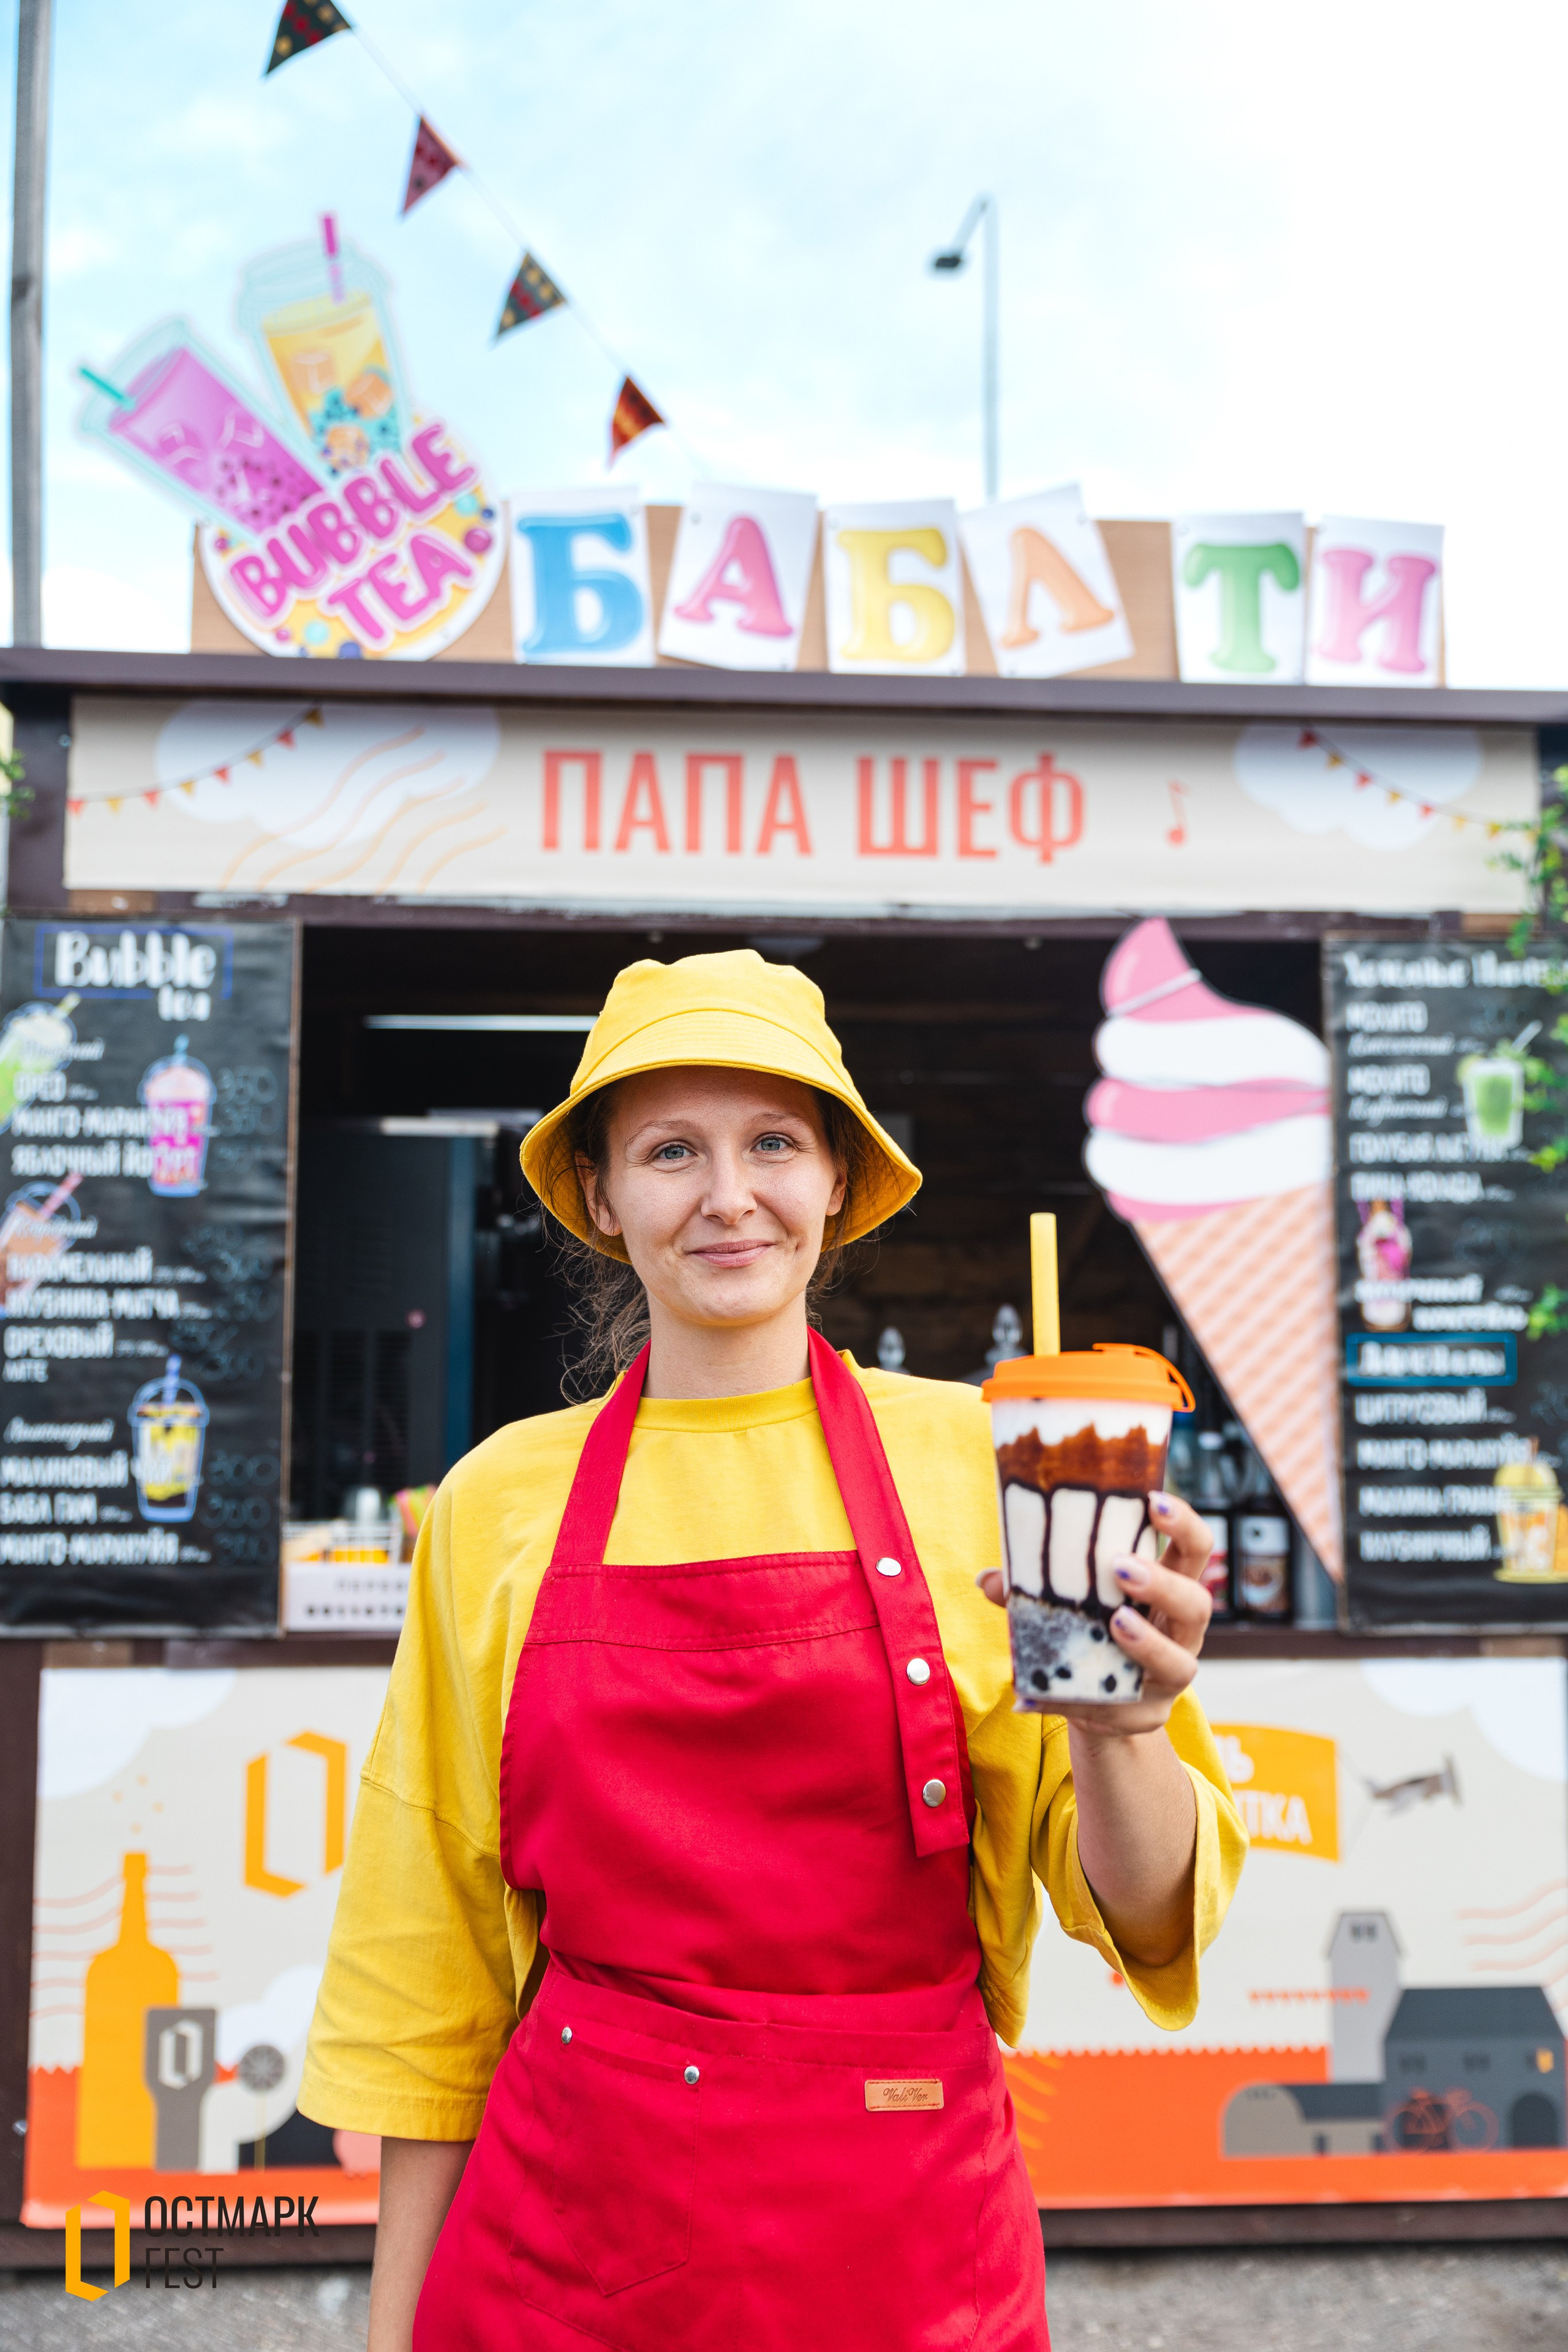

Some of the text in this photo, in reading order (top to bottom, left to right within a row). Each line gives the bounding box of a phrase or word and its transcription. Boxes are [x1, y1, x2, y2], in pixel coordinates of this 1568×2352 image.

[228, 423, 475, 618] BUBBLE
[326, 534, 472, 640] TEA
[1185, 541, 1438, 674] ТИ
[541, 750, 1085, 865] ПАПА ШЕФ
[55, 930, 217, 989] Bubble
[158, 985, 211, 1021] tea
